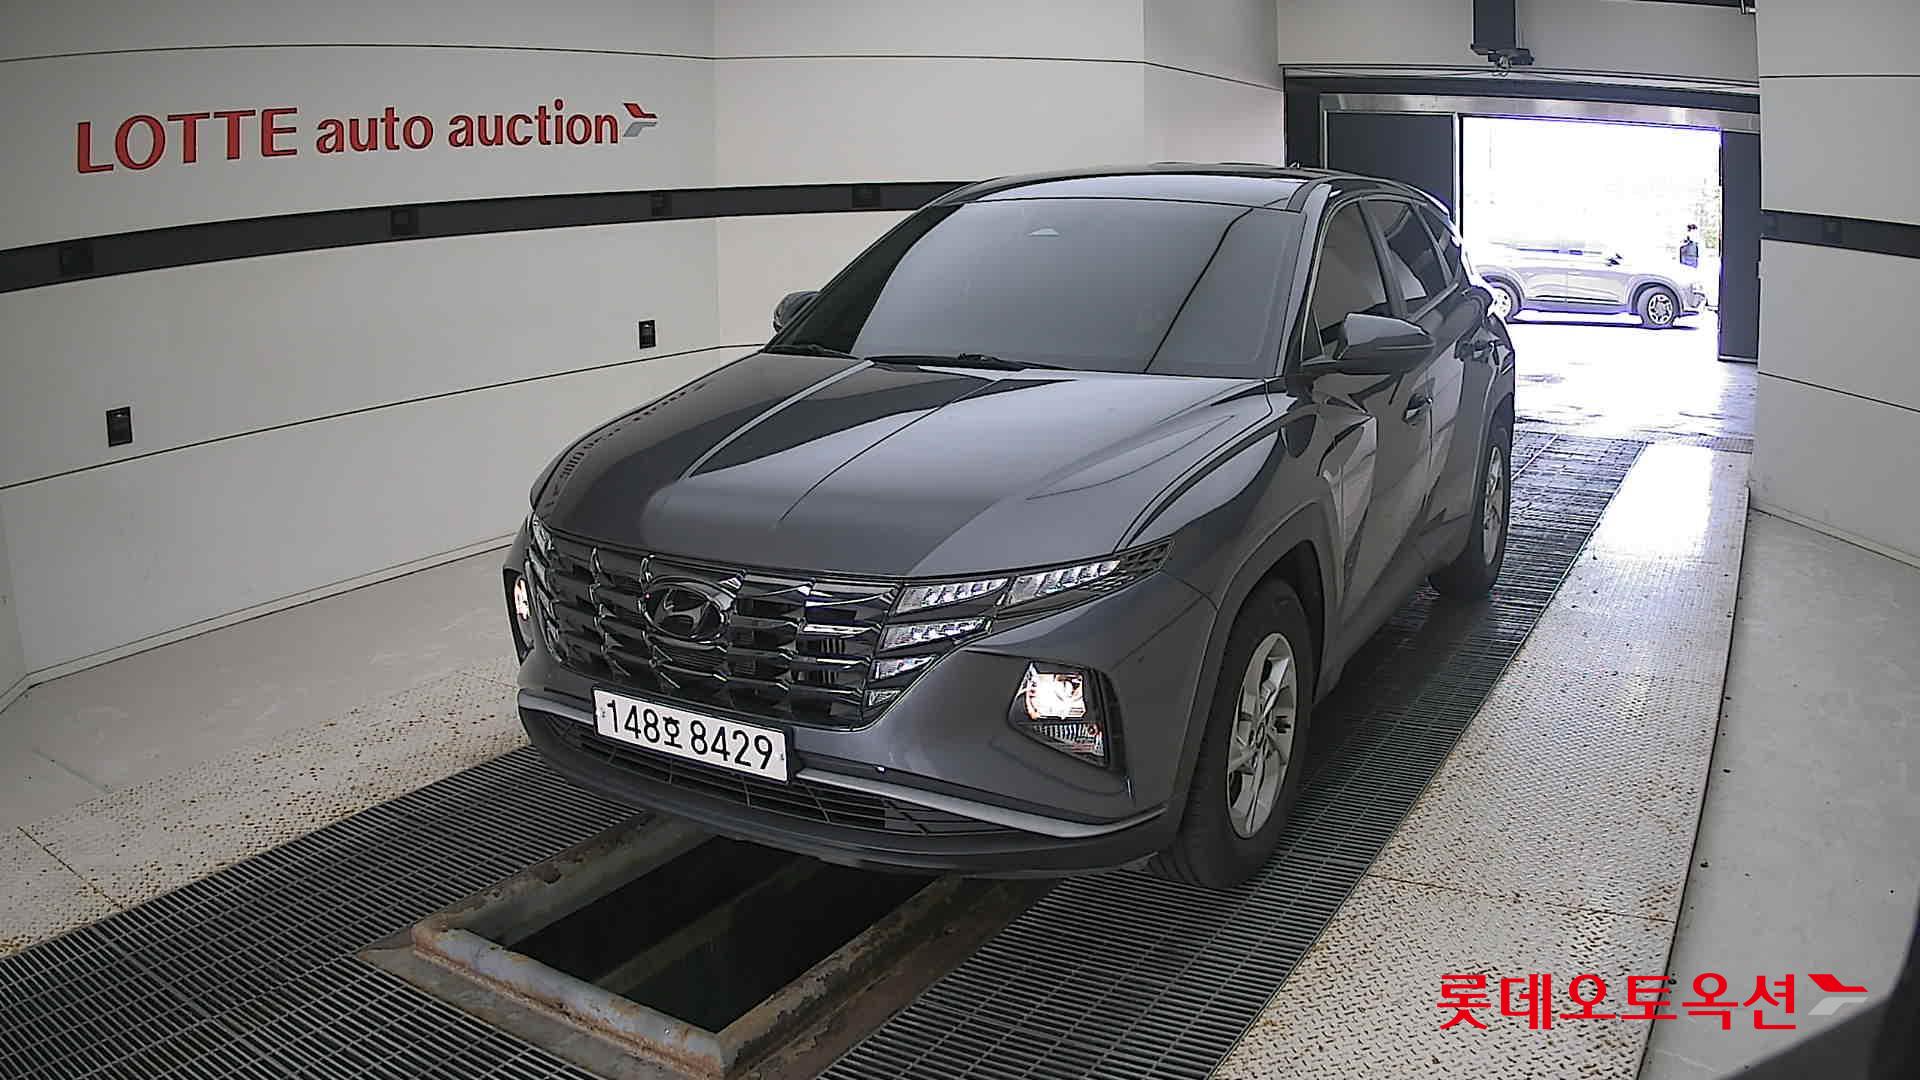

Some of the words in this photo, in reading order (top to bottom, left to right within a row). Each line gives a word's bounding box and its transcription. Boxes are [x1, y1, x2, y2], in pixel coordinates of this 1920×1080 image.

[76, 106, 299, 174] LOTTE
[316, 106, 434, 153] auto
[448, 99, 619, 147] auction
